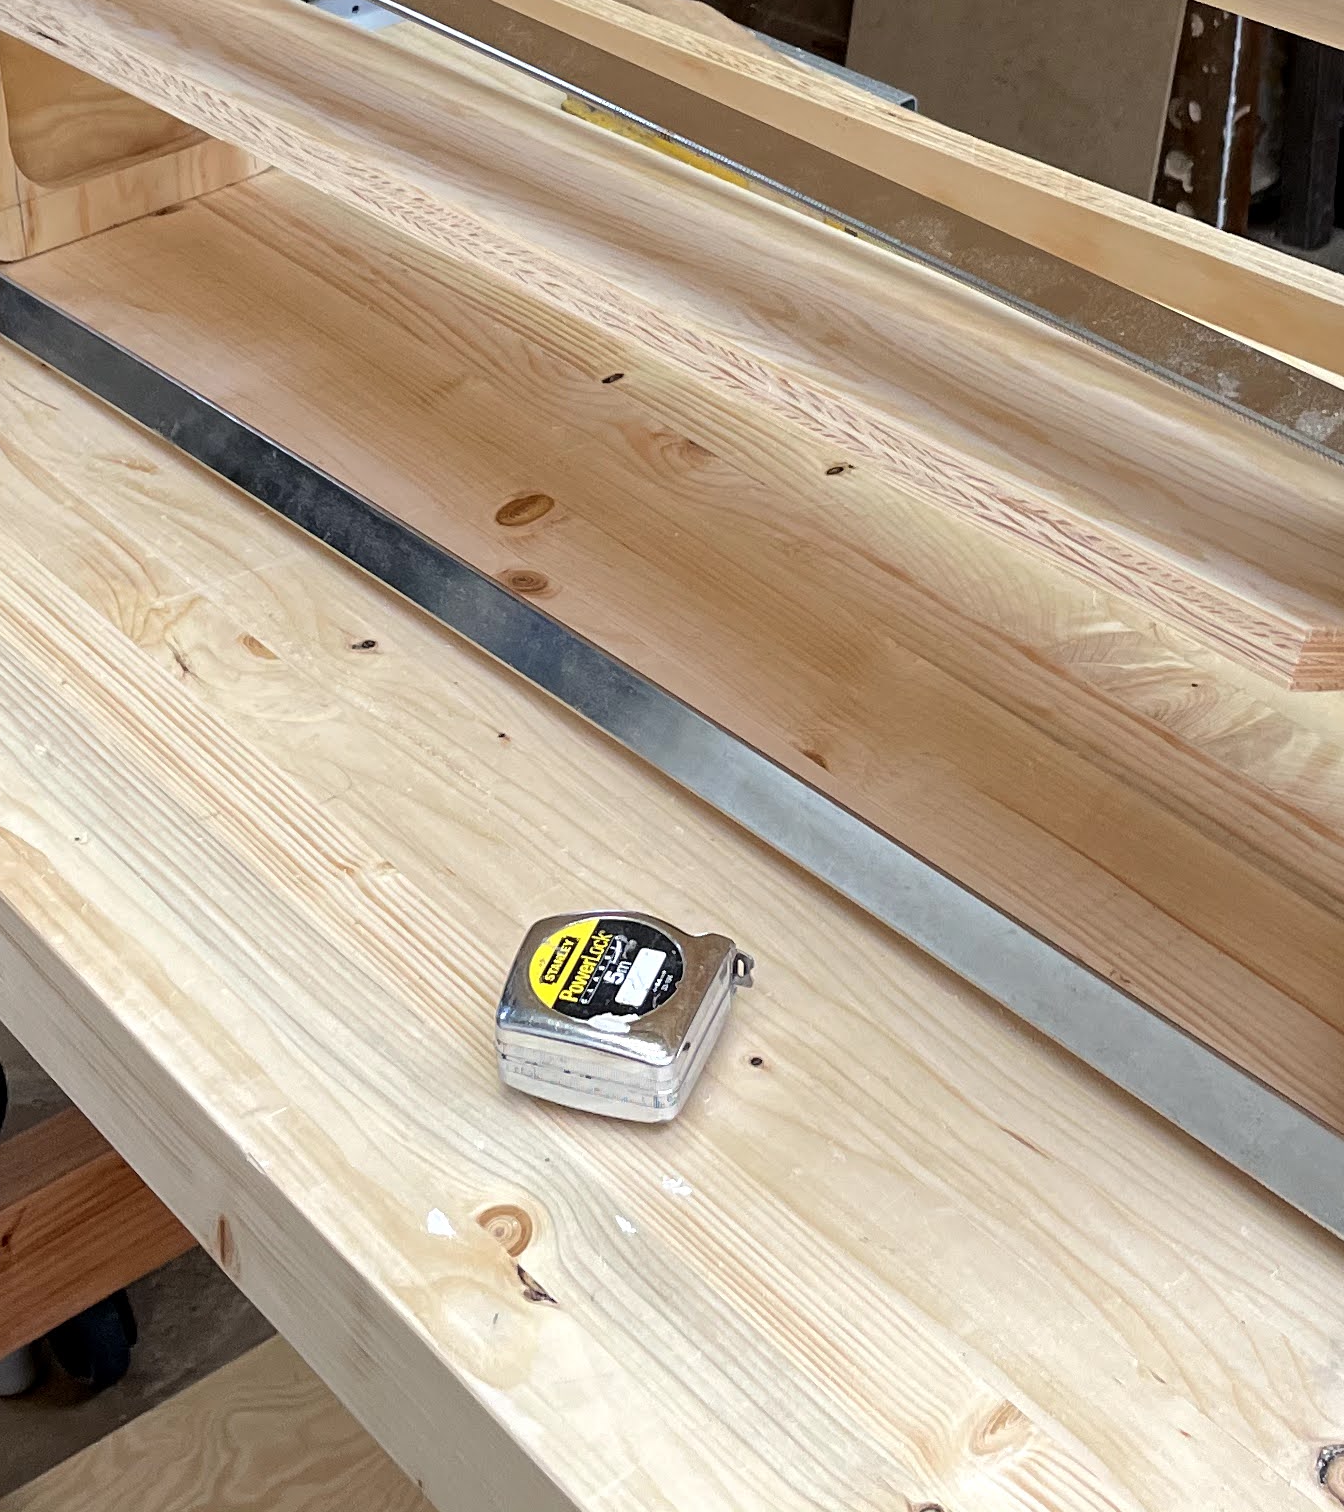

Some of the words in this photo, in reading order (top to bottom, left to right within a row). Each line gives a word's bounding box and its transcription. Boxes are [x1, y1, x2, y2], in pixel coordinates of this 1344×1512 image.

[544, 939, 575, 983] STANLEY
[558, 931, 614, 1003] PowerLock
[603, 960, 632, 986] 5m
